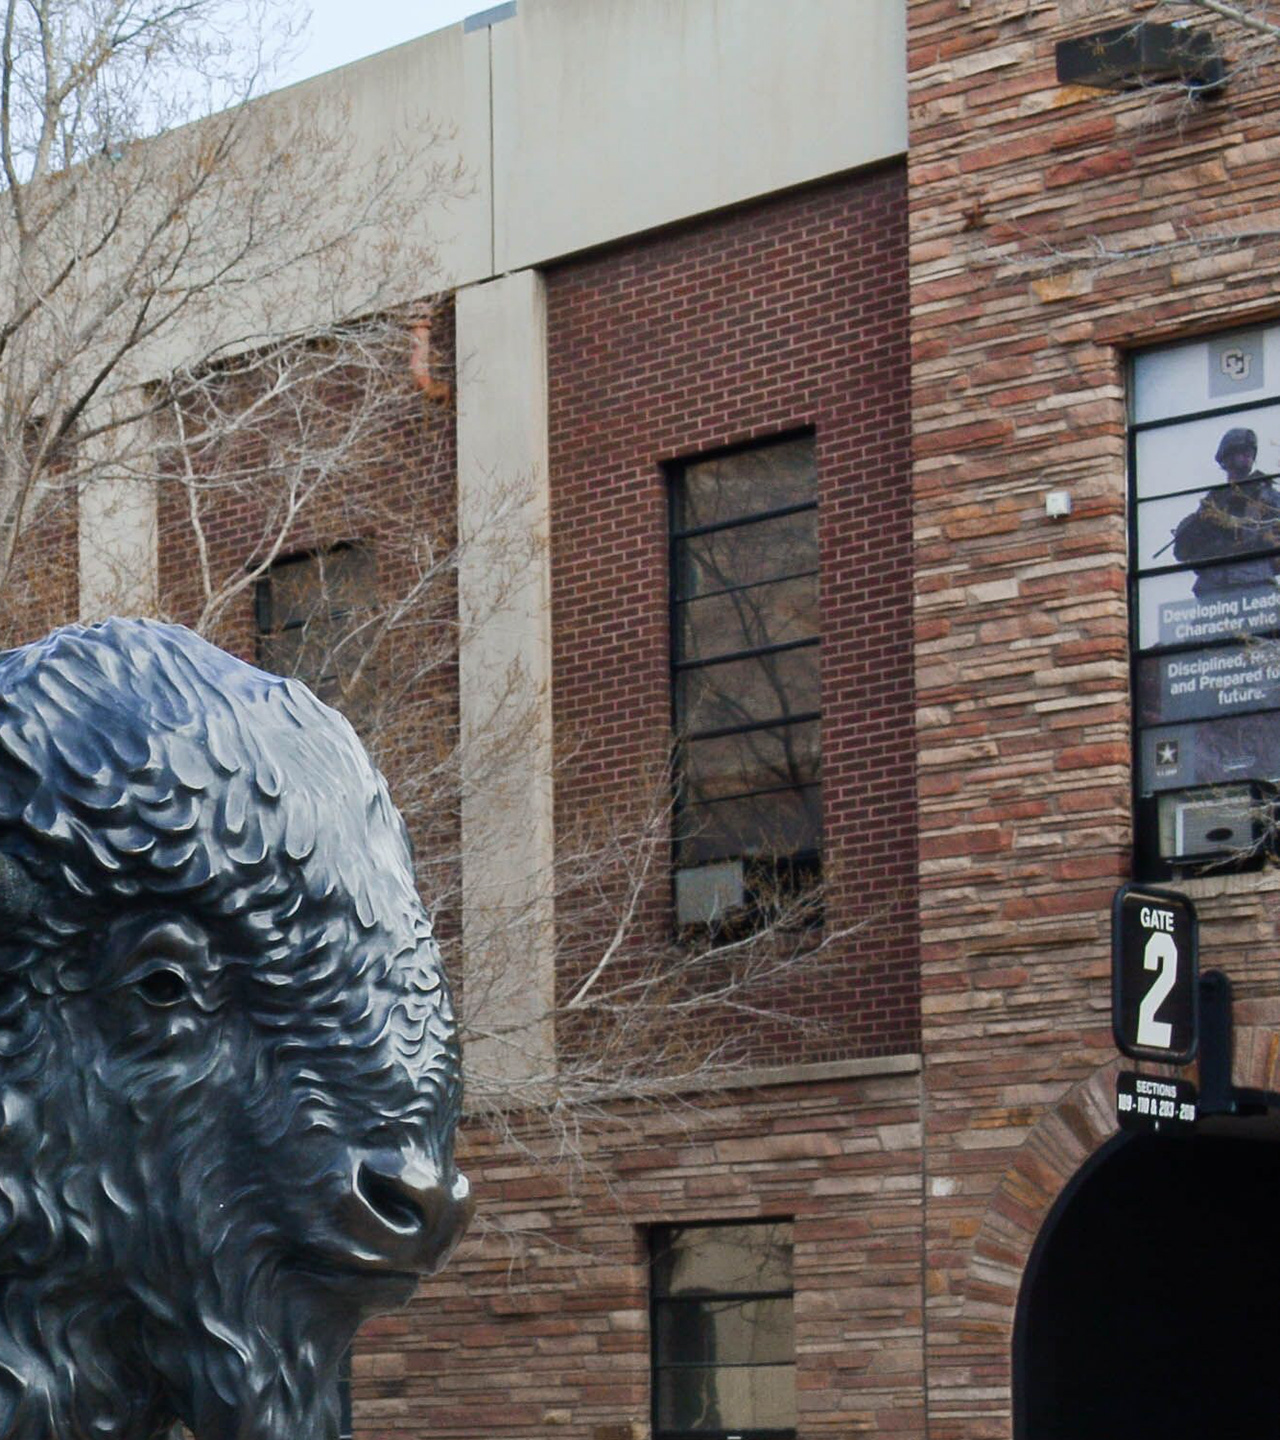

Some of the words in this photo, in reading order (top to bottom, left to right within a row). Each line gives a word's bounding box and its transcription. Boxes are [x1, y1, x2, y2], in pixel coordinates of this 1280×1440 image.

[1163, 601, 1238, 622] Developing
[1176, 617, 1244, 638] Character
[1248, 612, 1277, 626] who
[1168, 654, 1246, 677] Disciplined,
[1170, 679, 1196, 695] and
[1199, 669, 1262, 690] Prepared
[1218, 687, 1266, 704] future.
[1140, 907, 1174, 931] GATE
[1137, 931, 1178, 1048] 2
[1136, 1080, 1177, 1098] SECTIONS
